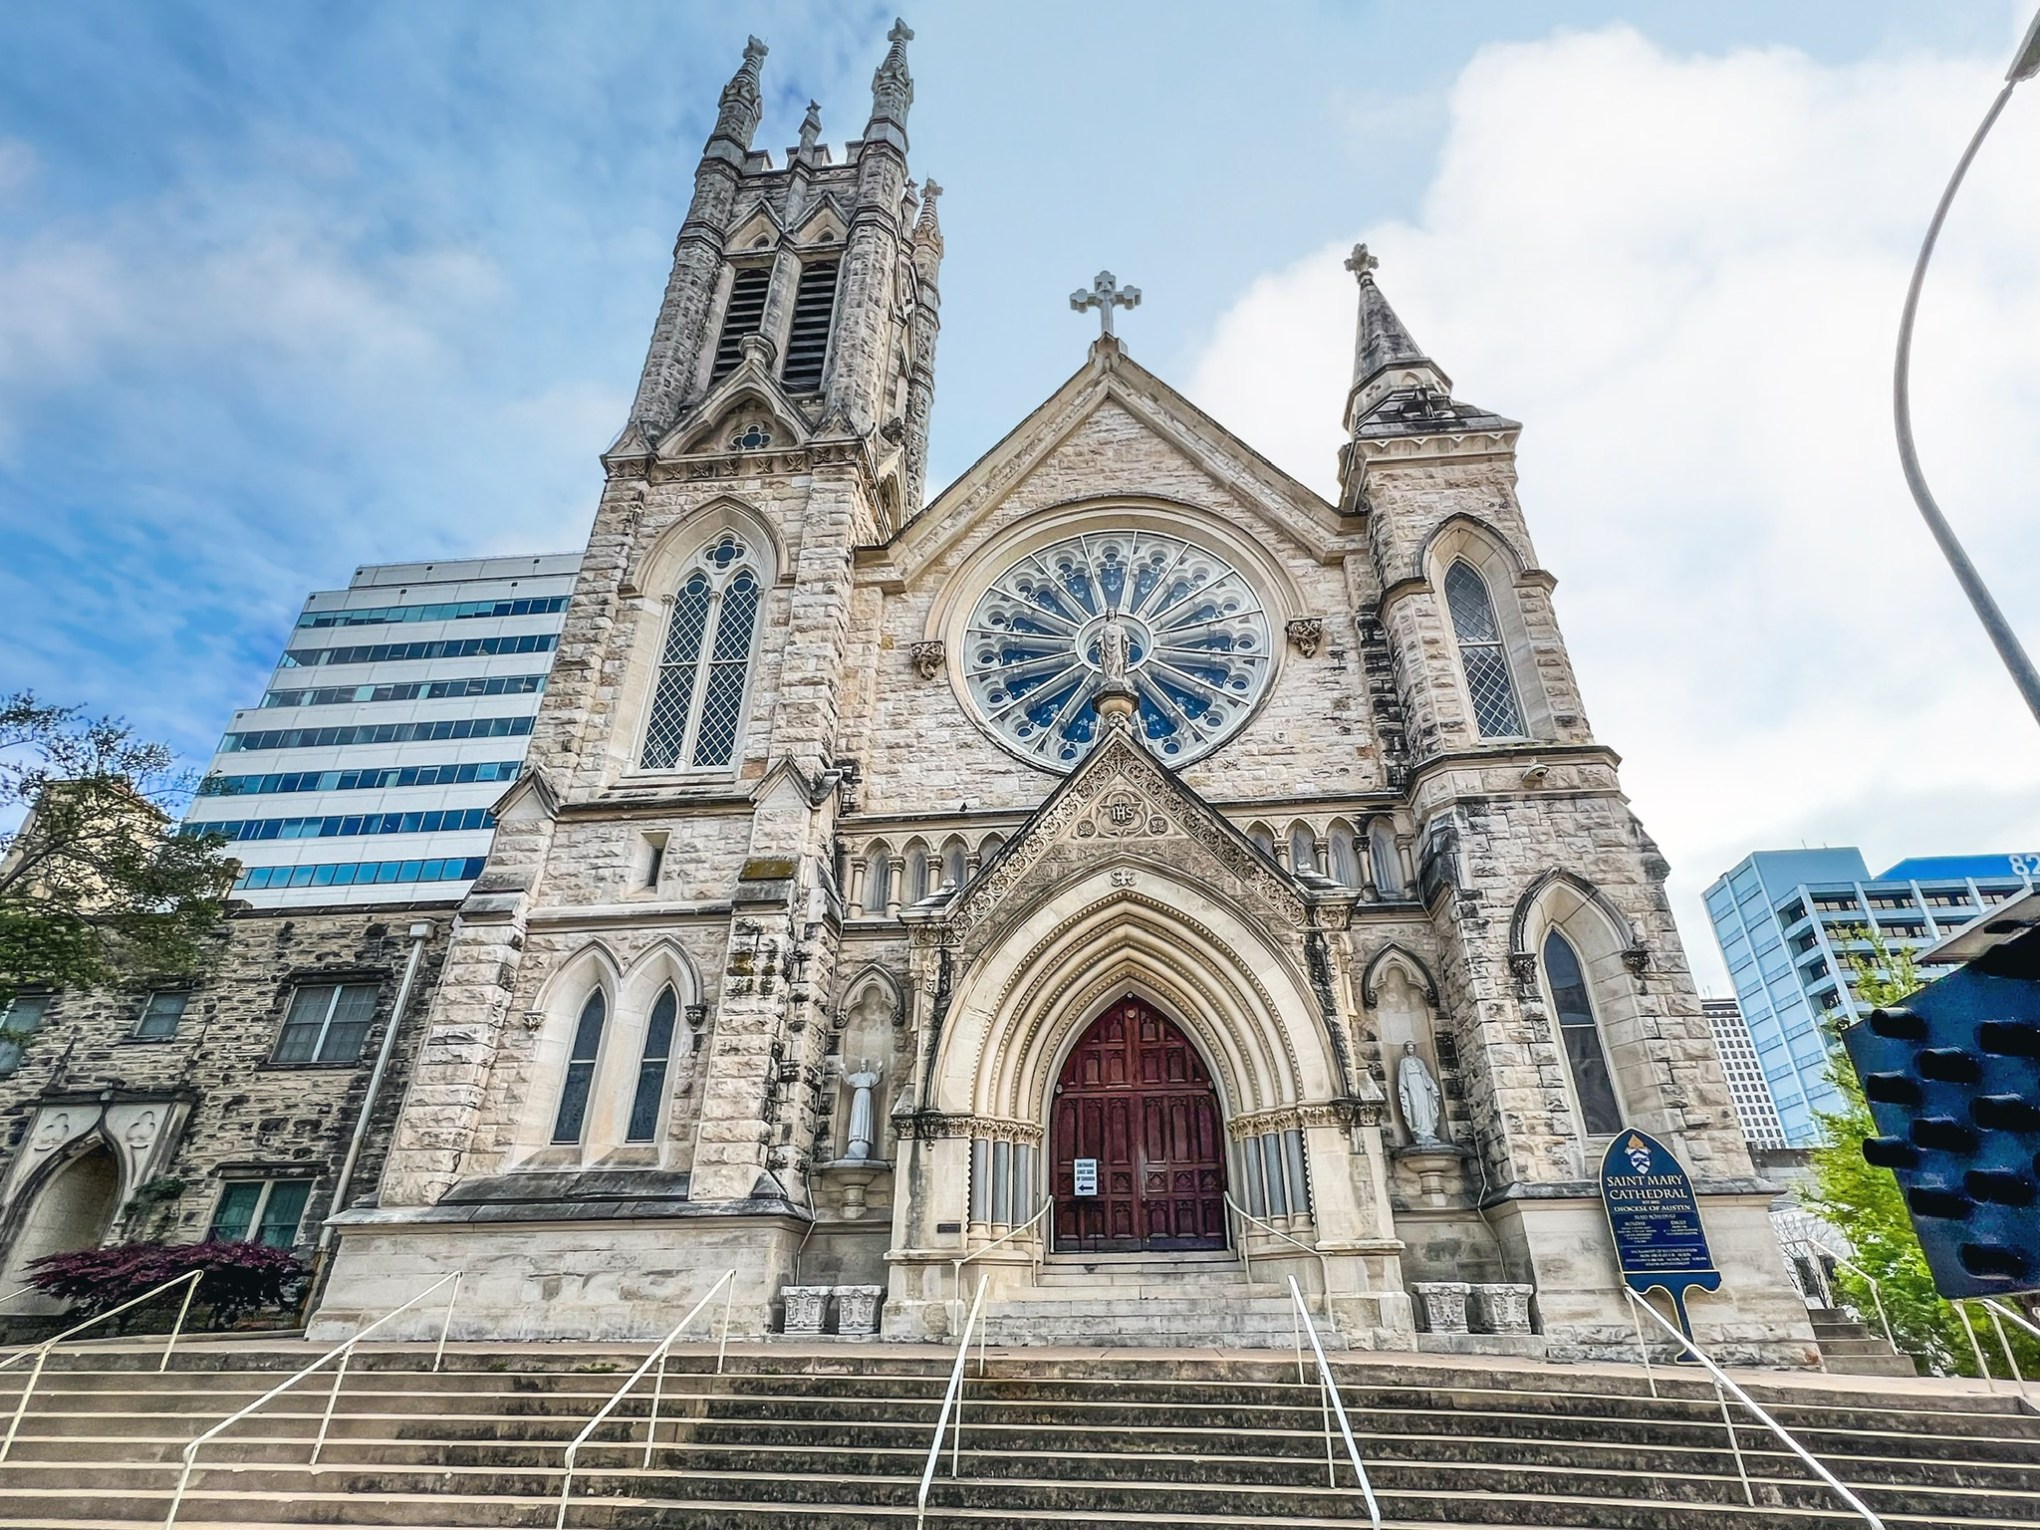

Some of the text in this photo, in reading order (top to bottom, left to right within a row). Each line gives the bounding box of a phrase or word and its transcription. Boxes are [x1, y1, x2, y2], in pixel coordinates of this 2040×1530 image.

[1606, 1175, 1682, 1187] SAINT MARY
[1609, 1188, 1688, 1200] CATHEDRAL
